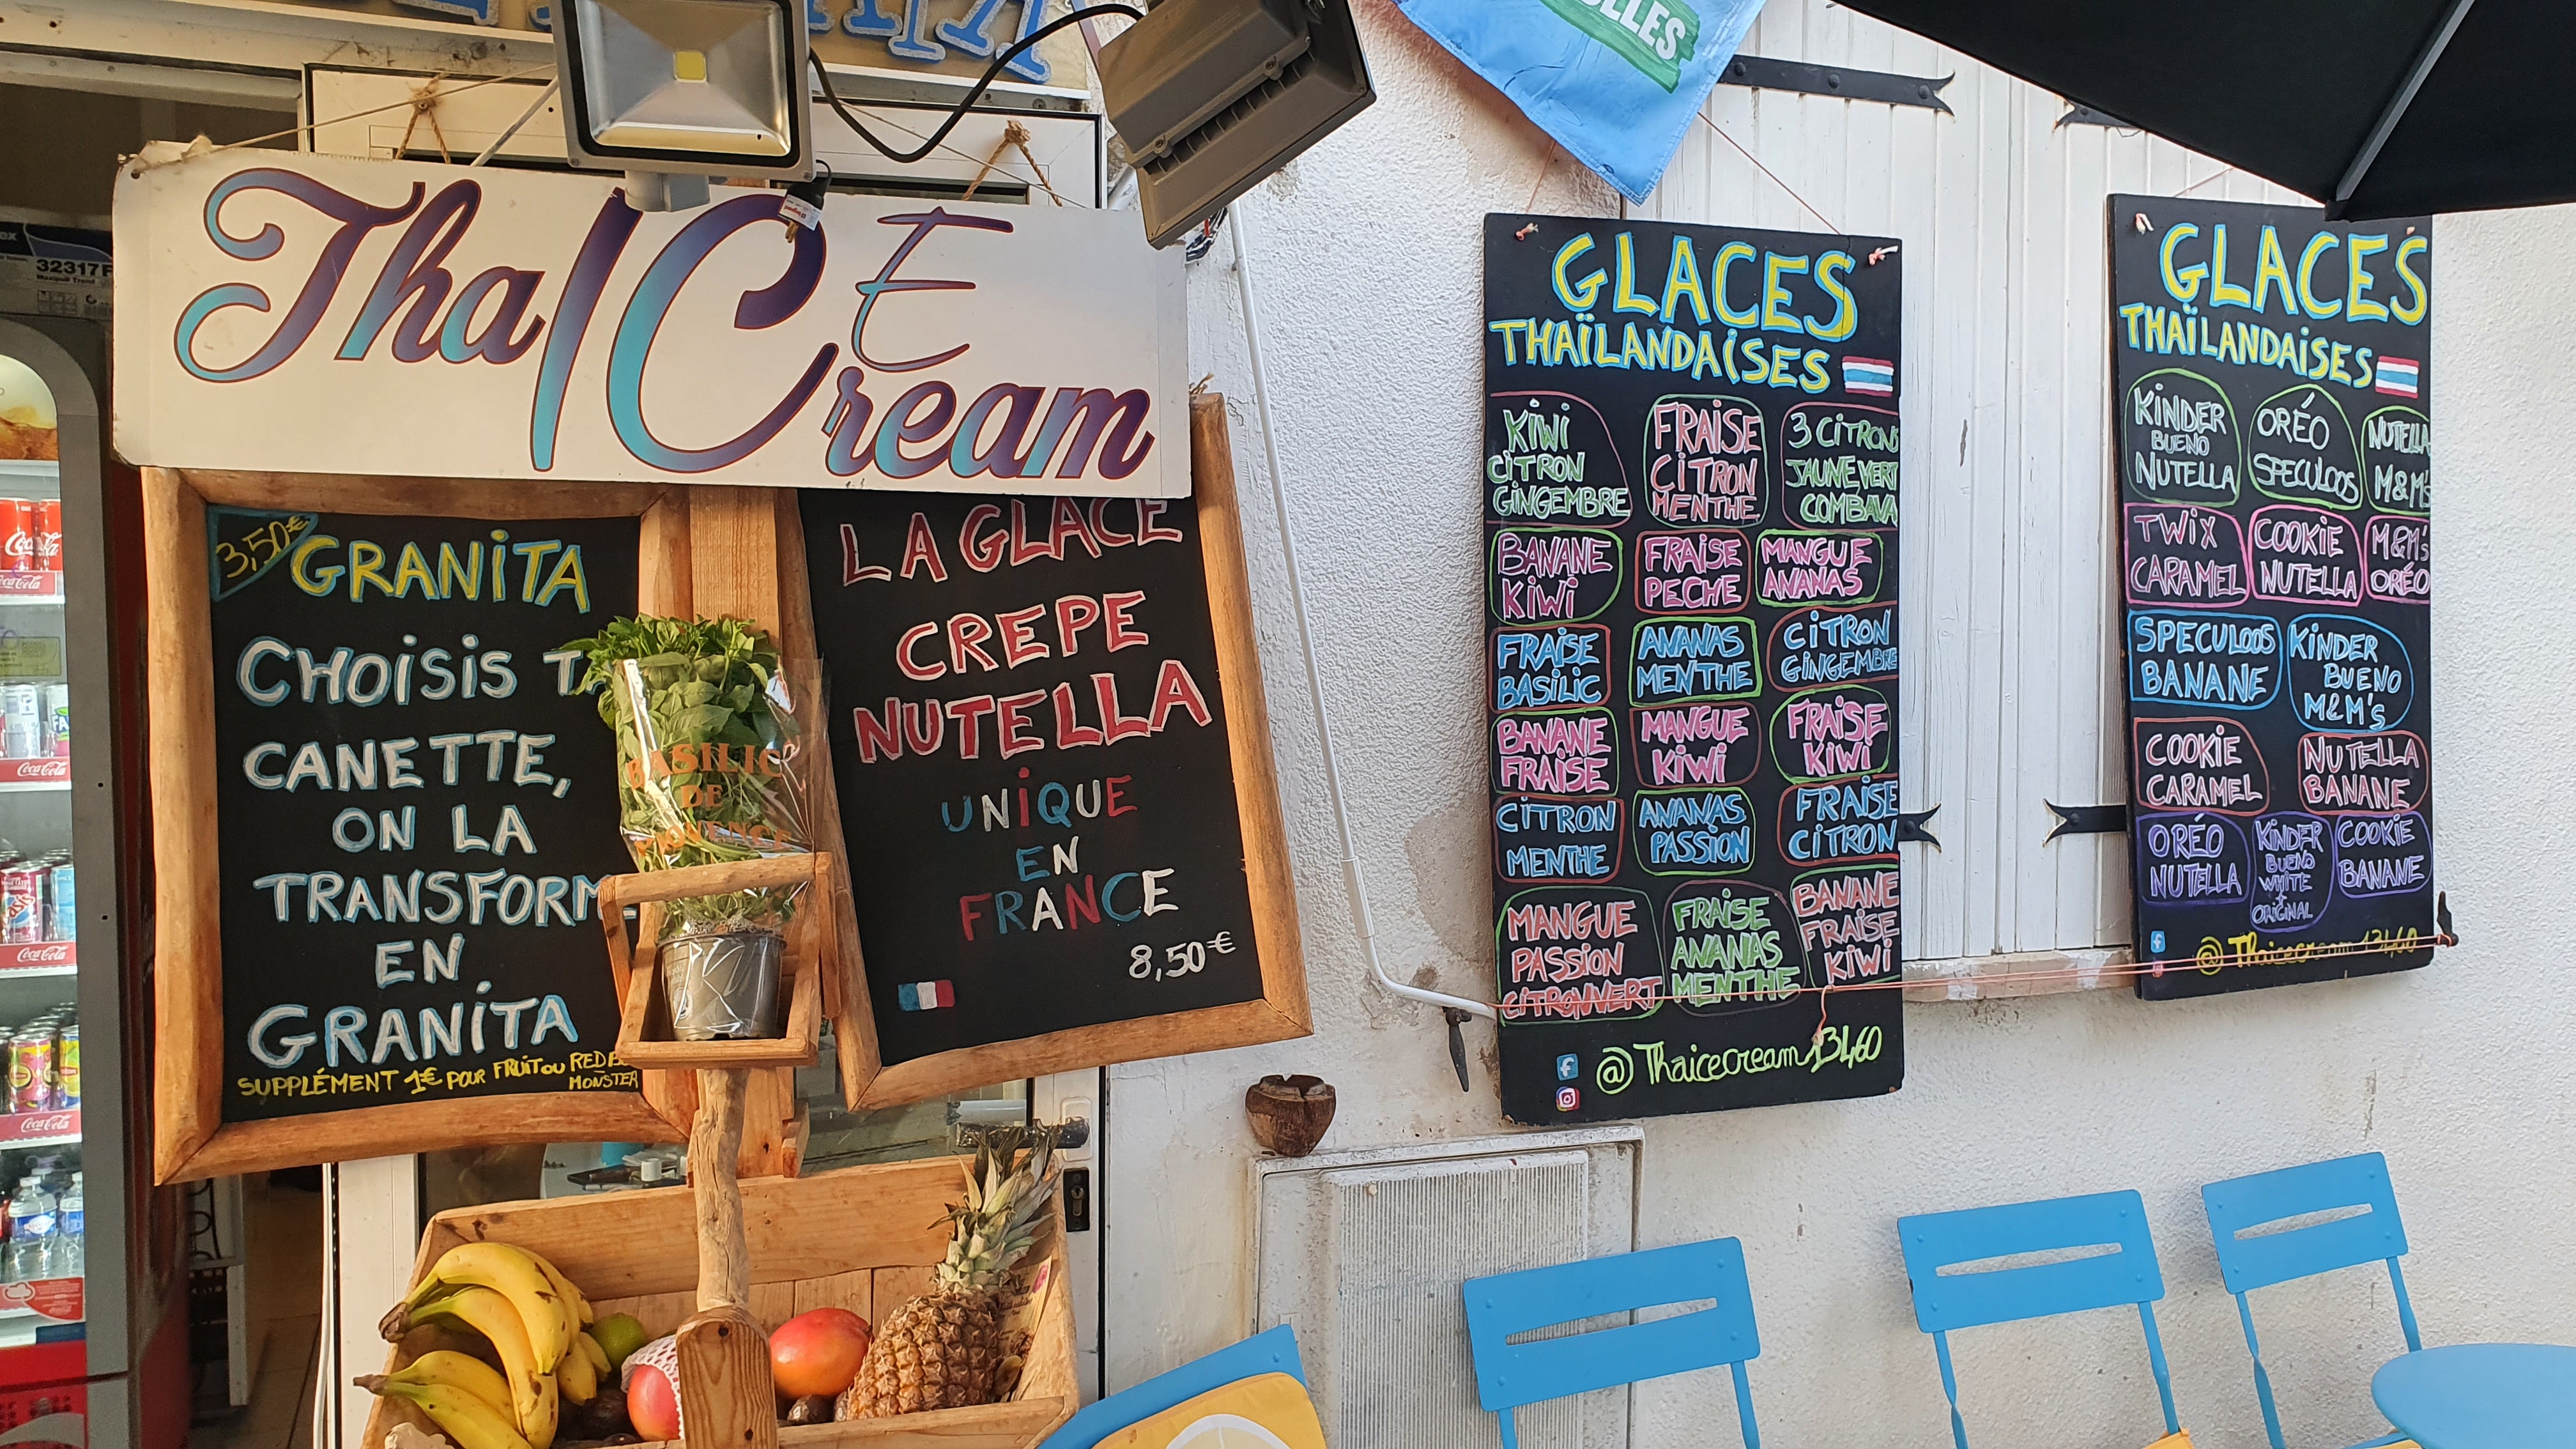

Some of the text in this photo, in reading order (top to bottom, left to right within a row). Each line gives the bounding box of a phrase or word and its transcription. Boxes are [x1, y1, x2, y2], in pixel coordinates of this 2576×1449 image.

[1581, 0, 1687, 60] LLES
[1551, 231, 1858, 343] GLACES
[2159, 222, 2428, 326] GLACES
[1788, 412, 1813, 448] 3
[2257, 391, 2329, 450] ORÉO
[2368, 417, 2430, 456] NUTELLA
[2150, 429, 2210, 457] BUENO
[1857, 460, 1899, 491] VERT
[2135, 450, 2236, 495] NUTELLA
[2252, 452, 2359, 504] SPECULOOS
[1652, 492, 1761, 522] MENTHE
[1800, 491, 1898, 528] COMBAVA
[215, 514, 309, 579] 3,50€
[840, 497, 1183, 586] LA GLACE
[1497, 533, 1614, 578] BANANE
[1760, 537, 1873, 570] MANGUE
[1644, 574, 1742, 609] PECHE
[1761, 566, 1863, 599] ANANAS
[2129, 555, 2246, 598] CARAMEL
[2260, 559, 2358, 600] NUTELLA
[2370, 561, 2430, 595] ORÉO
[896, 590, 1149, 681] CREPE
[1638, 622, 1744, 660] ANANAS
[2134, 615, 2276, 654] SPECULOOS
[1637, 661, 1753, 698] MENTHE
[2140, 658, 2269, 703] BANANE
[2324, 662, 2402, 694] BUENO
[853, 659, 1213, 763] NUTELLA
[1641, 706, 1751, 744] MANGUE
[1496, 717, 1612, 756] BANANE
[2303, 735, 2420, 774] NUTELLA
[243, 730, 571, 799] CANETTE,
[626, 742, 782, 790] BASILIC
[680, 784, 724, 809] DE
[2145, 772, 2263, 808] CARAMEL
[2303, 773, 2411, 810] BANANE
[332, 804, 538, 855] ON LA
[1639, 793, 1747, 829] ANANAS
[2147, 813, 2225, 860] ORÉO
[1016, 836, 1079, 882] EN
[1506, 845, 1610, 877] MENTHE
[2265, 852, 2315, 873] BUENO
[2338, 854, 2426, 889] BANANE
[253, 868, 638, 926] TRANSFORM
[1791, 871, 1899, 918] BANANE
[2150, 862, 2243, 898] NUTELLA
[959, 868, 1179, 941] FRANCE
[1507, 900, 1638, 942] MANGUE
[375, 933, 465, 989] EN
[1128, 931, 1236, 981] 8,50€
[1670, 931, 1783, 970] ANANAS
[1671, 967, 1800, 1008] MENTHE
[237, 1068, 400, 1098] SUPPLÉMENT
[404, 1066, 443, 1094] 1€
[447, 1068, 487, 1090] POUR
[569, 1051, 606, 1073] RED
[569, 1070, 638, 1091] MONSTER
